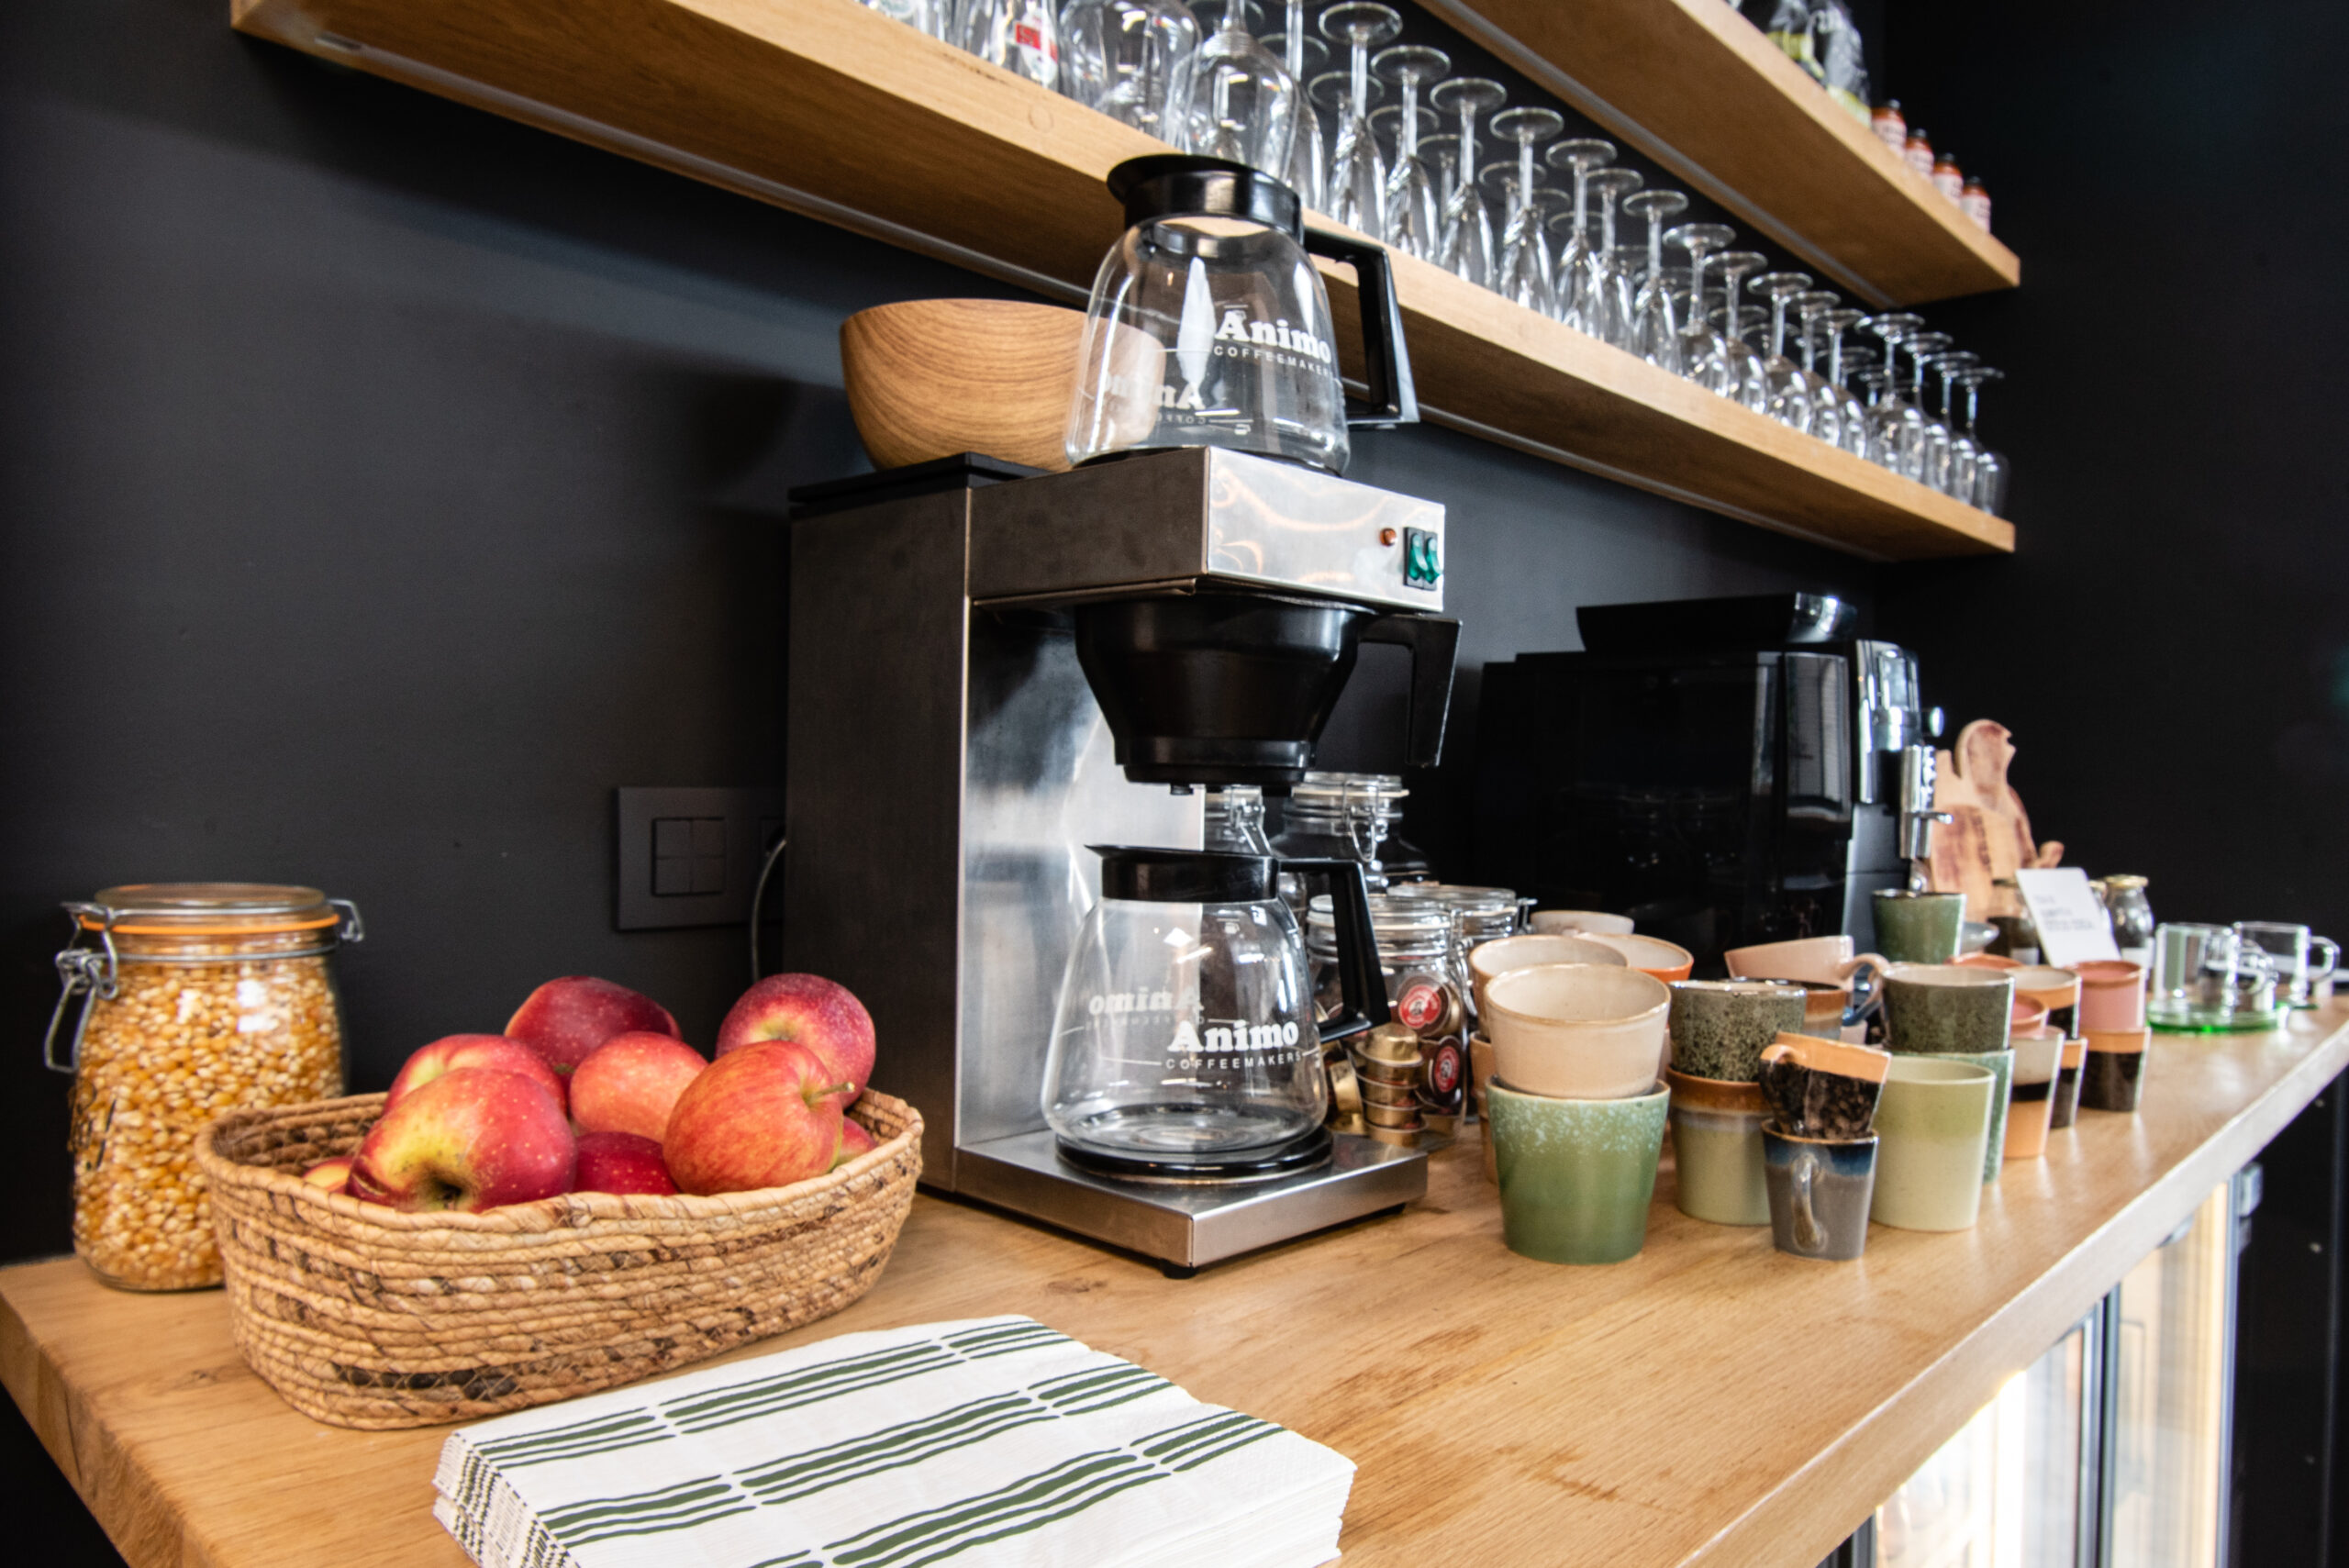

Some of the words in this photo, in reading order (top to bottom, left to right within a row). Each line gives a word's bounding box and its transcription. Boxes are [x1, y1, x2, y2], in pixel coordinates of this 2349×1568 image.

[1214, 309, 1332, 364] Animo
[1166, 1018, 1299, 1053] Animo
[1165, 1051, 1301, 1070] COFFEEMAKERS
